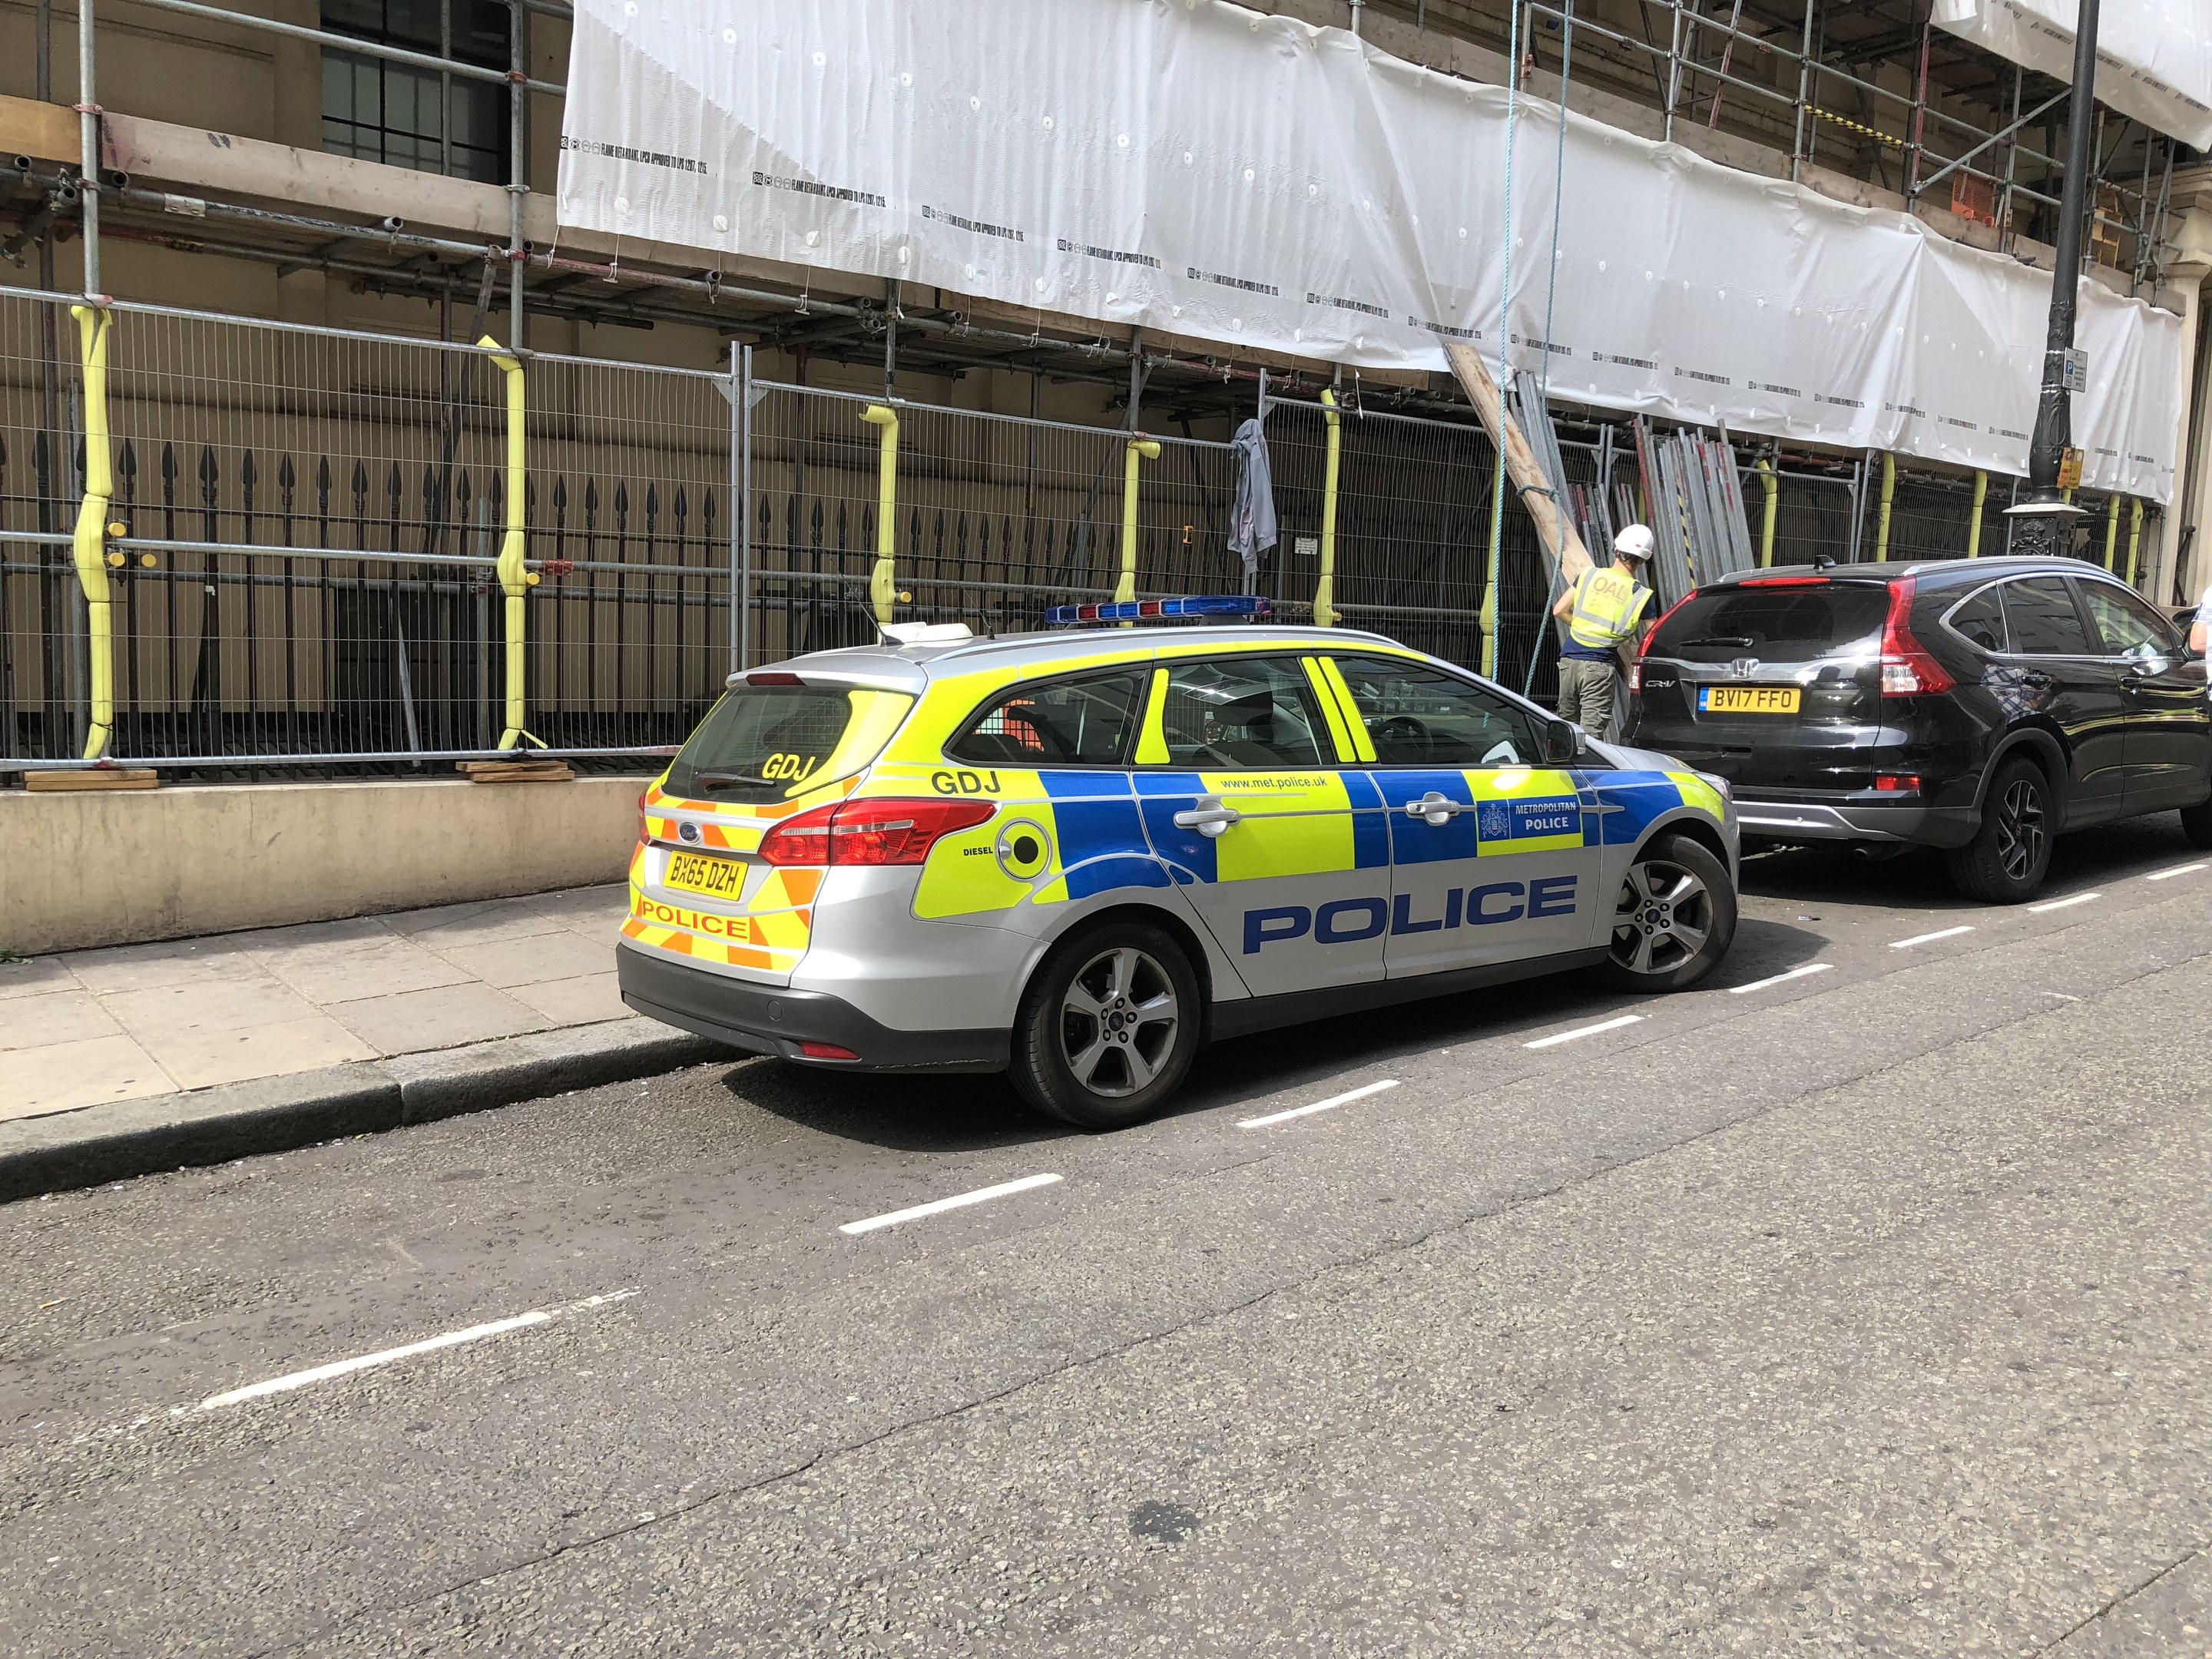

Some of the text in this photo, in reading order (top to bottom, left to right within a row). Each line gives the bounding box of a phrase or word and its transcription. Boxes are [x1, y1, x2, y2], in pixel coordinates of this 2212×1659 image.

[601, 143, 614, 157] FLAME
[651, 153, 671, 167] APPROVED
[671, 156, 676, 169] TO
[792, 179, 804, 193] FLAME
[1714, 690, 1792, 708] BV17 FFO
[761, 753, 816, 782] GDJ
[932, 770, 1001, 795] GDJ
[1220, 777, 1328, 790] www.met.police.uk
[1515, 801, 1576, 815] METROPOLITAN
[1525, 816, 1569, 830] POLICE
[963, 846, 993, 856] DIESEL
[670, 856, 740, 893] BX65 DZH
[642, 900, 748, 939] POLICE
[1243, 875, 1578, 955] POLICE
